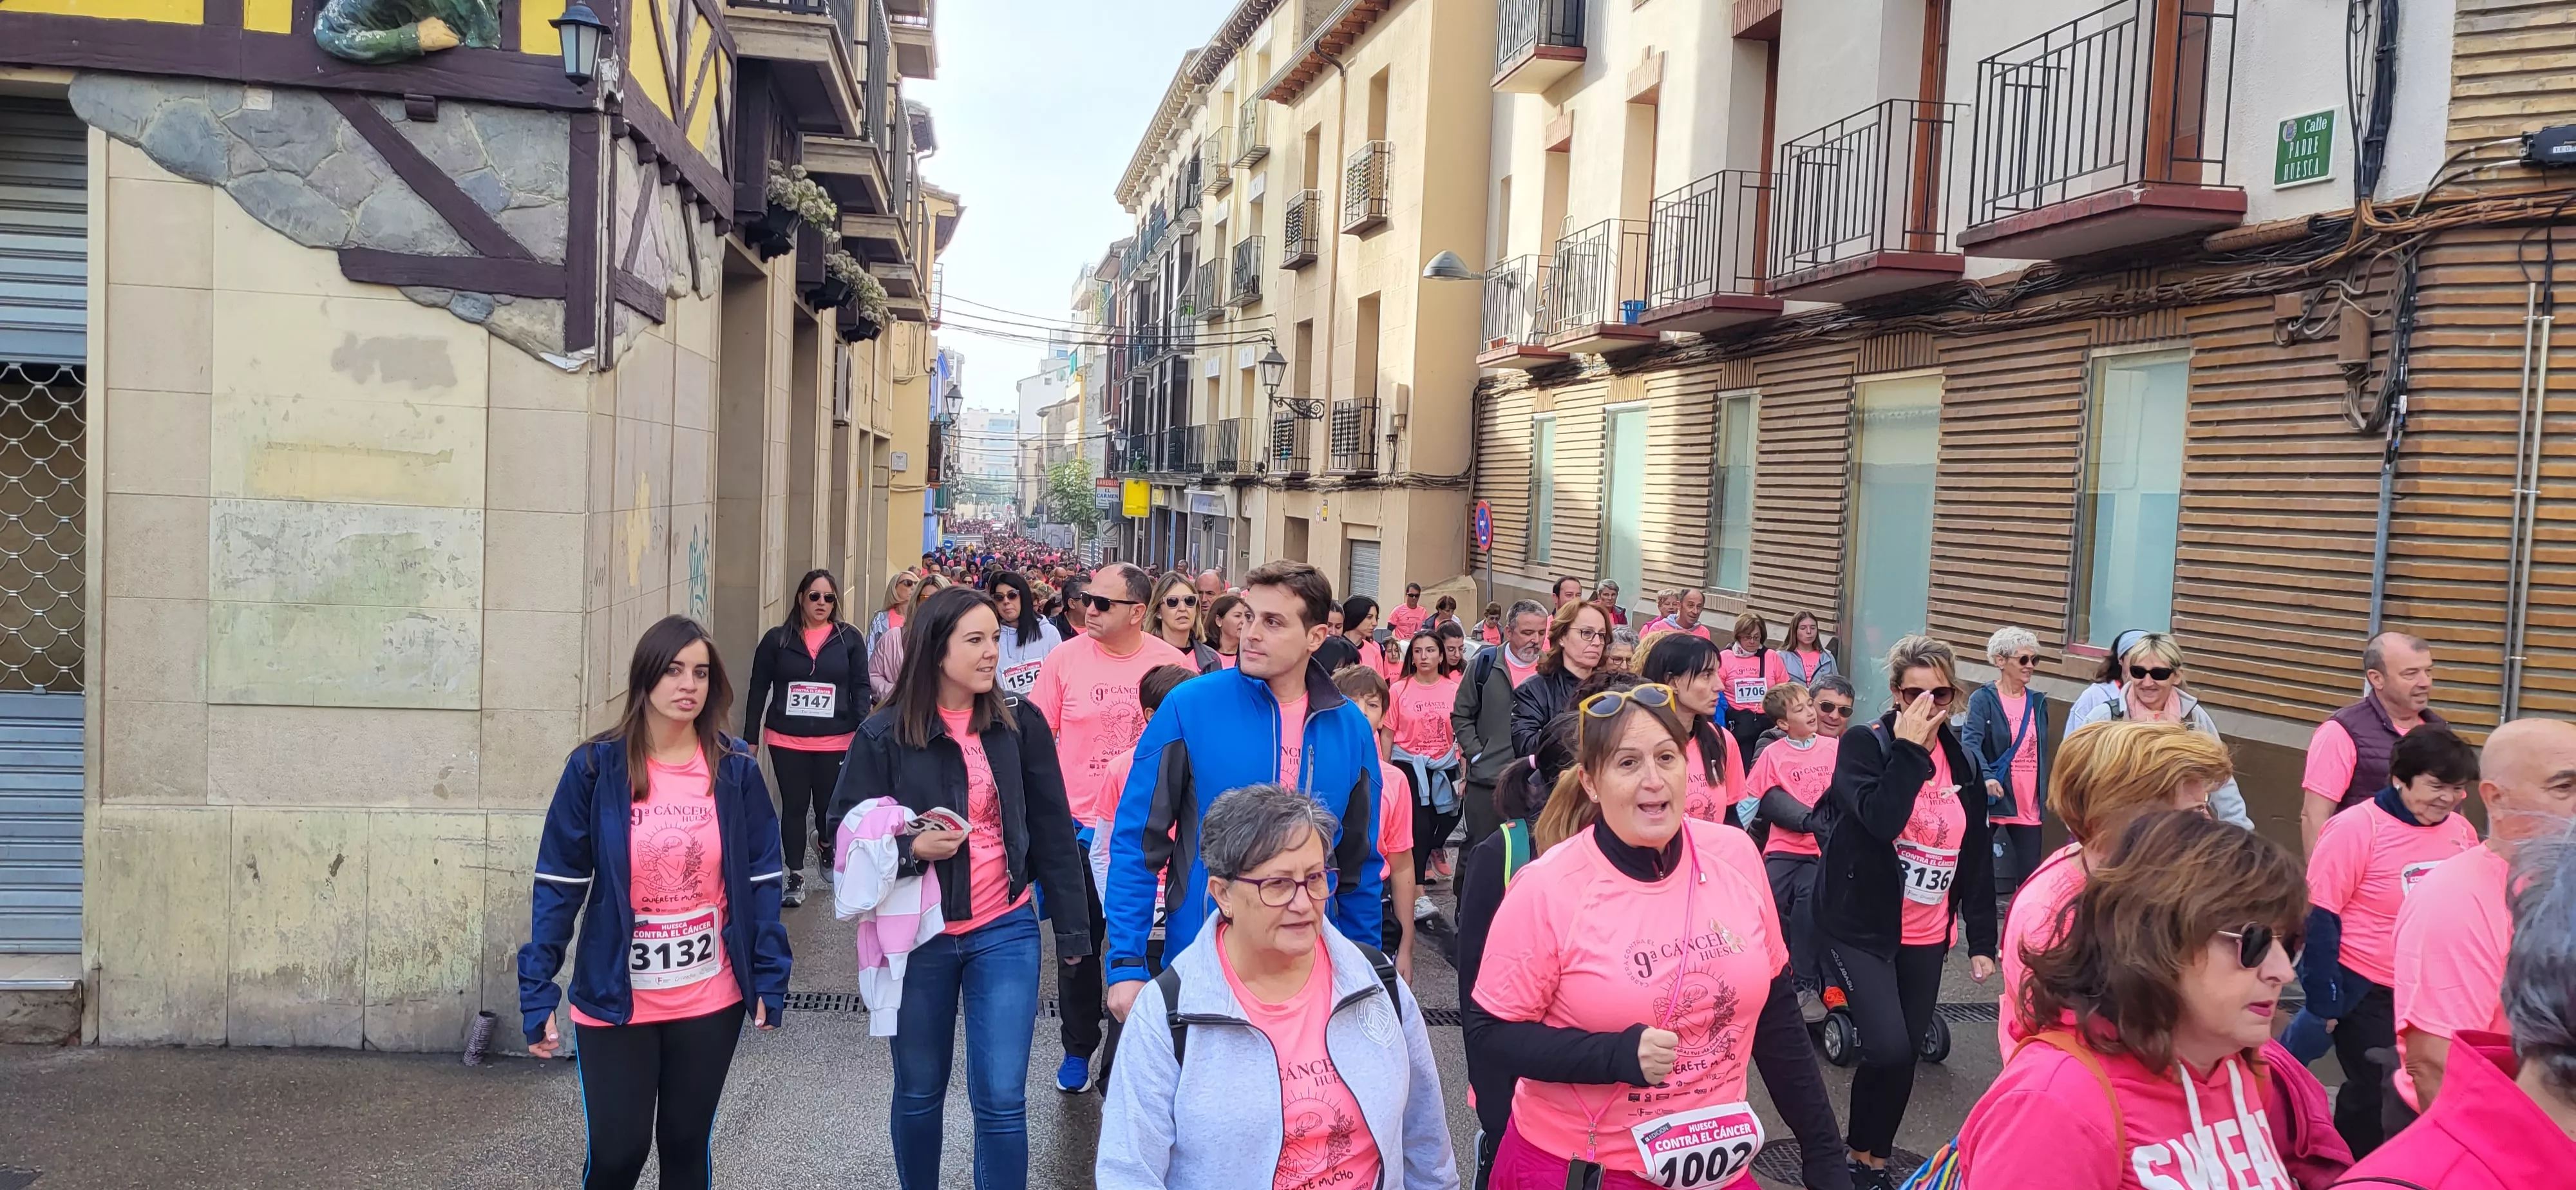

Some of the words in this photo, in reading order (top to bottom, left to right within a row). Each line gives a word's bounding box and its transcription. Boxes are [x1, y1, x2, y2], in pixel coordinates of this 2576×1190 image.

[2304, 117, 2327, 133] Calle
[2289, 136, 2318, 158] PADRE
[2284, 157, 2318, 180] HUESCA
[1095, 688, 1108, 701] 9ª
[1739, 687, 1765, 697] 1706
[791, 694, 831, 708] 3147
[631, 808, 649, 826] 9ª
[1901, 851, 1929, 864] CONTRA
[641, 894, 679, 903] QUIÉRETE
[681, 892, 703, 901] MUCHO
[661, 922, 687, 930] HUESCA
[683, 921, 711, 935] CÁNCER
[631, 933, 712, 970] 3132
[1634, 950, 1658, 979] 9ª
[1649, 1126, 1669, 1140] EDICIÓN
[1689, 1120, 1718, 1133] HUESCA
[1655, 1135, 1700, 1151] CONTRA
[1701, 1131, 1713, 1143] EL
[1714, 1122, 1752, 1140] CÁNCER
[1660, 1141, 1752, 1188] 1002
[1318, 1169, 1354, 1187] MUCHO
